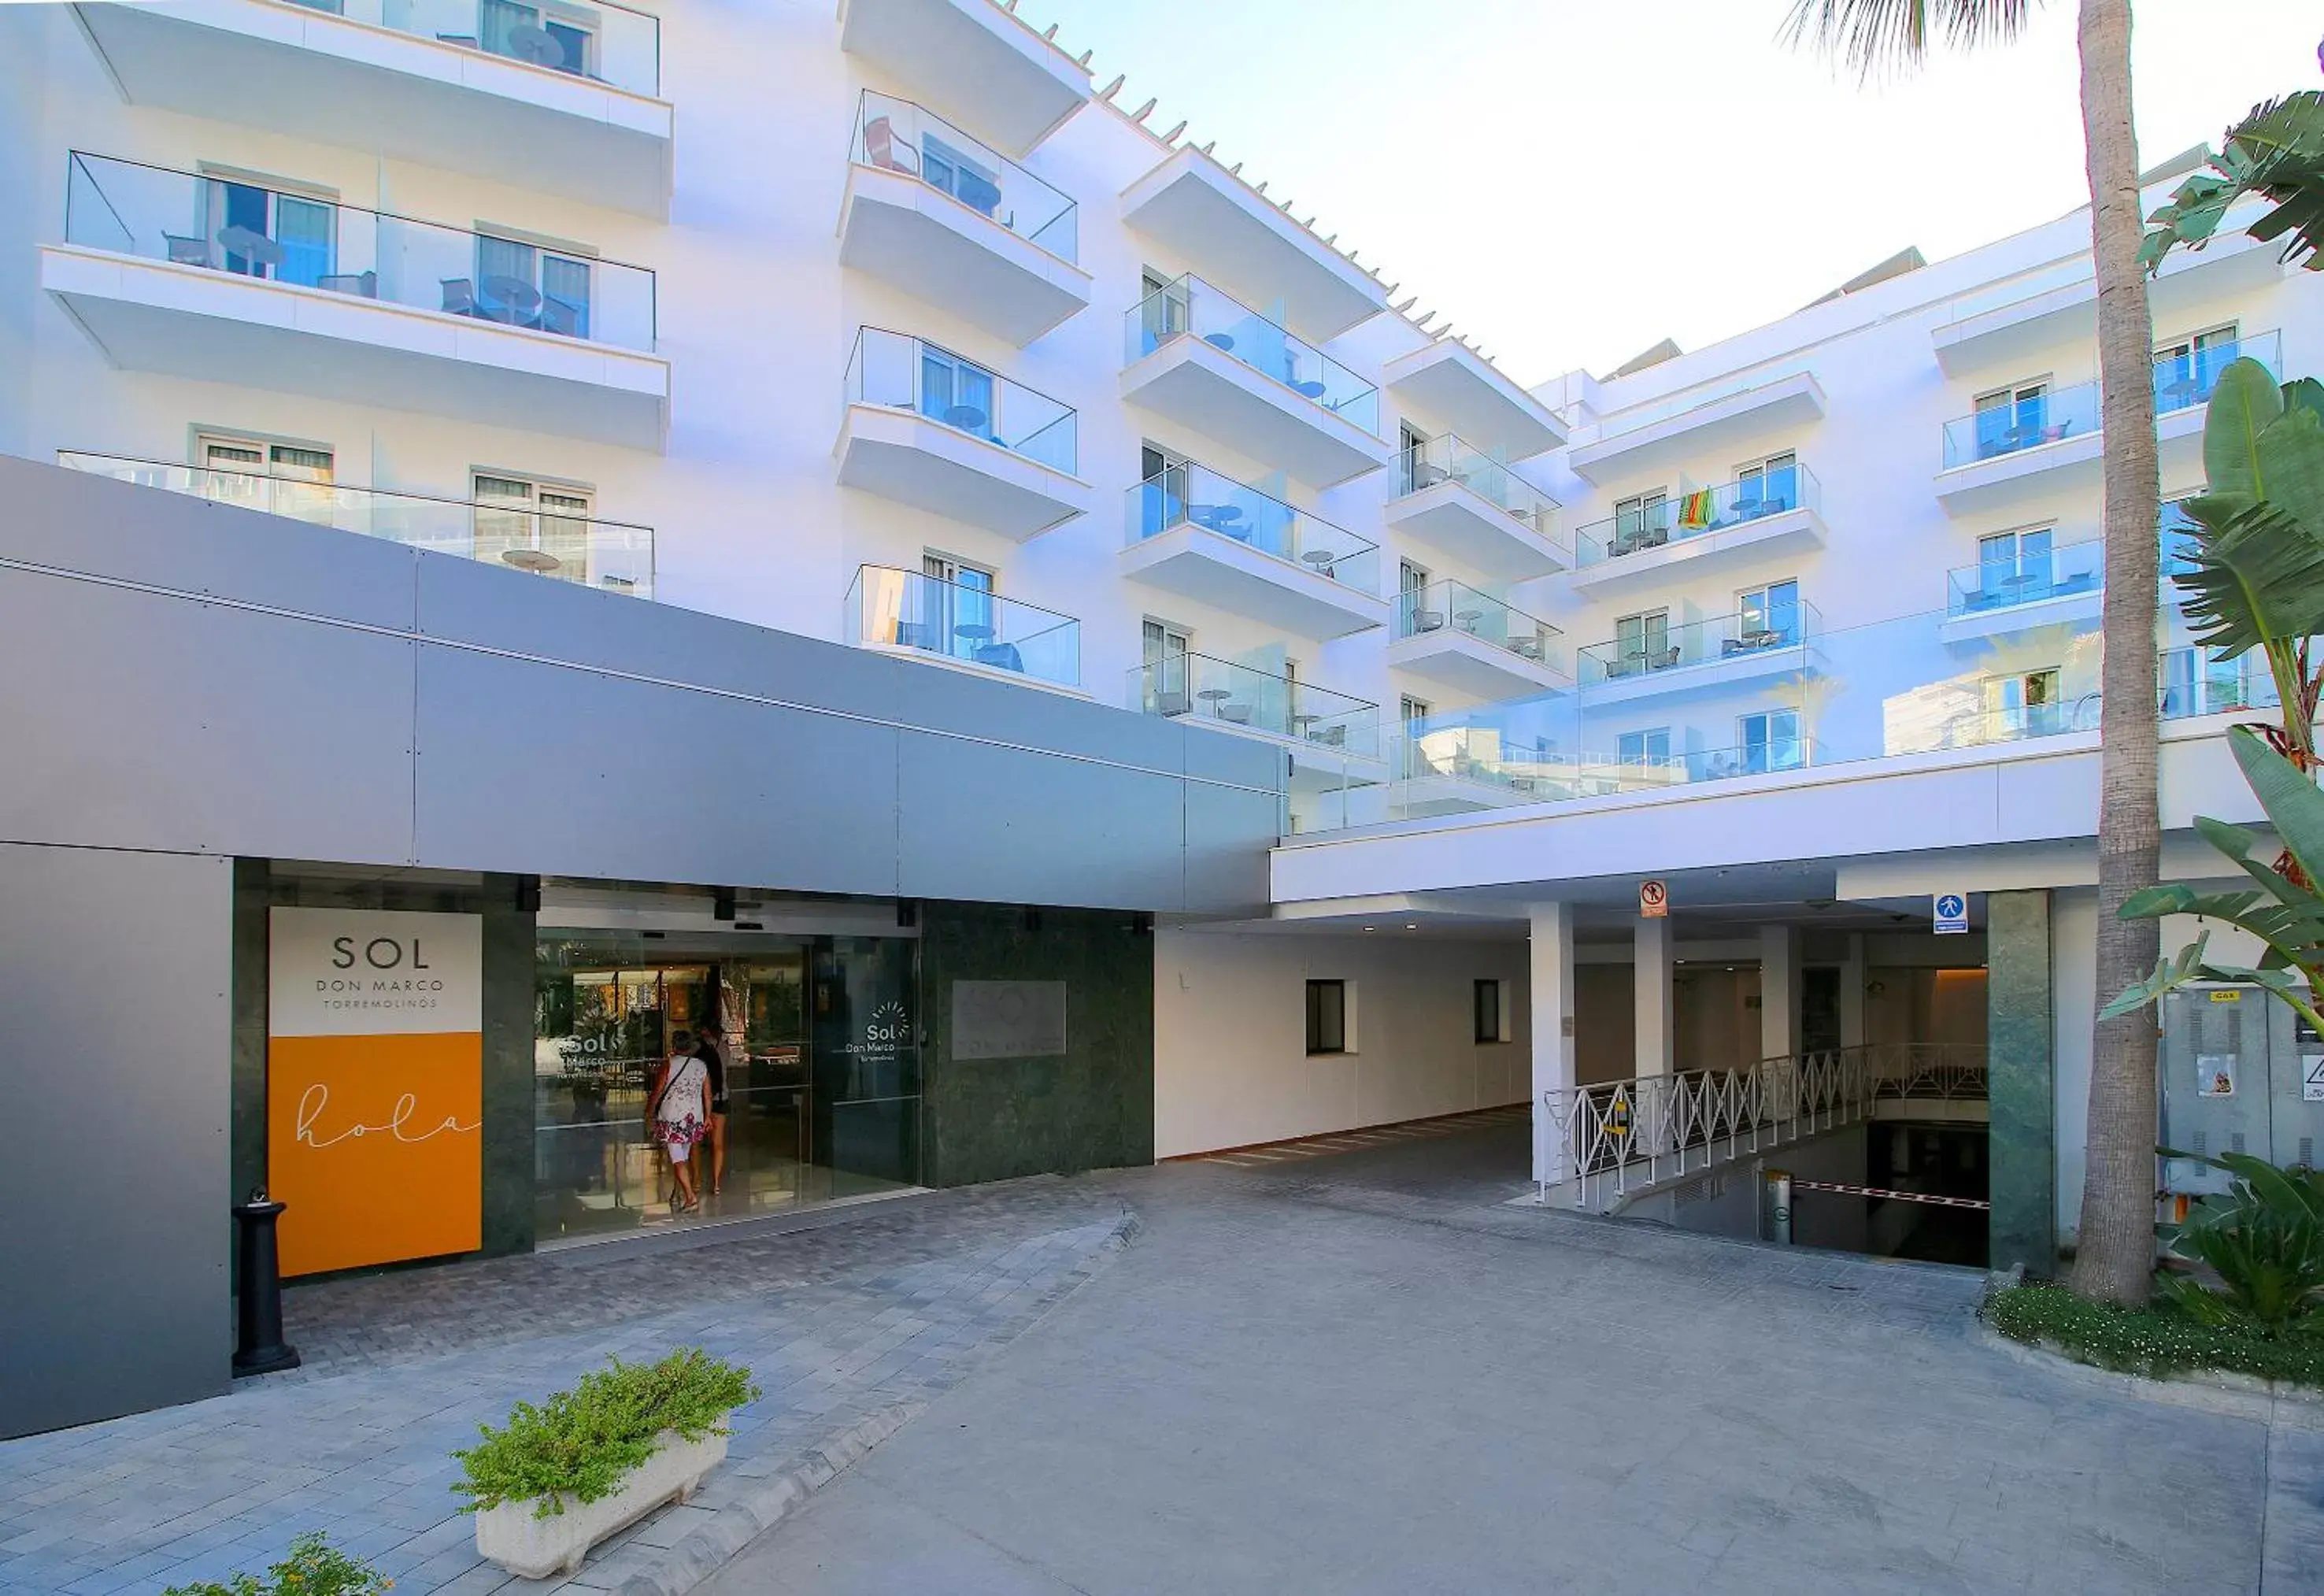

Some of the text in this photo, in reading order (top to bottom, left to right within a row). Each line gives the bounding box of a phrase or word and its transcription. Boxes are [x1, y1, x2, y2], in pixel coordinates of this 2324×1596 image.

[332, 937, 429, 969] SOL
[316, 980, 443, 992] DON MARCO
[324, 998, 437, 1009] TORREMOLINOS
[867, 1024, 895, 1040] Sol
[565, 1033, 608, 1054] Sol
[846, 1043, 866, 1053] Don
[297, 1084, 482, 1147] hola
